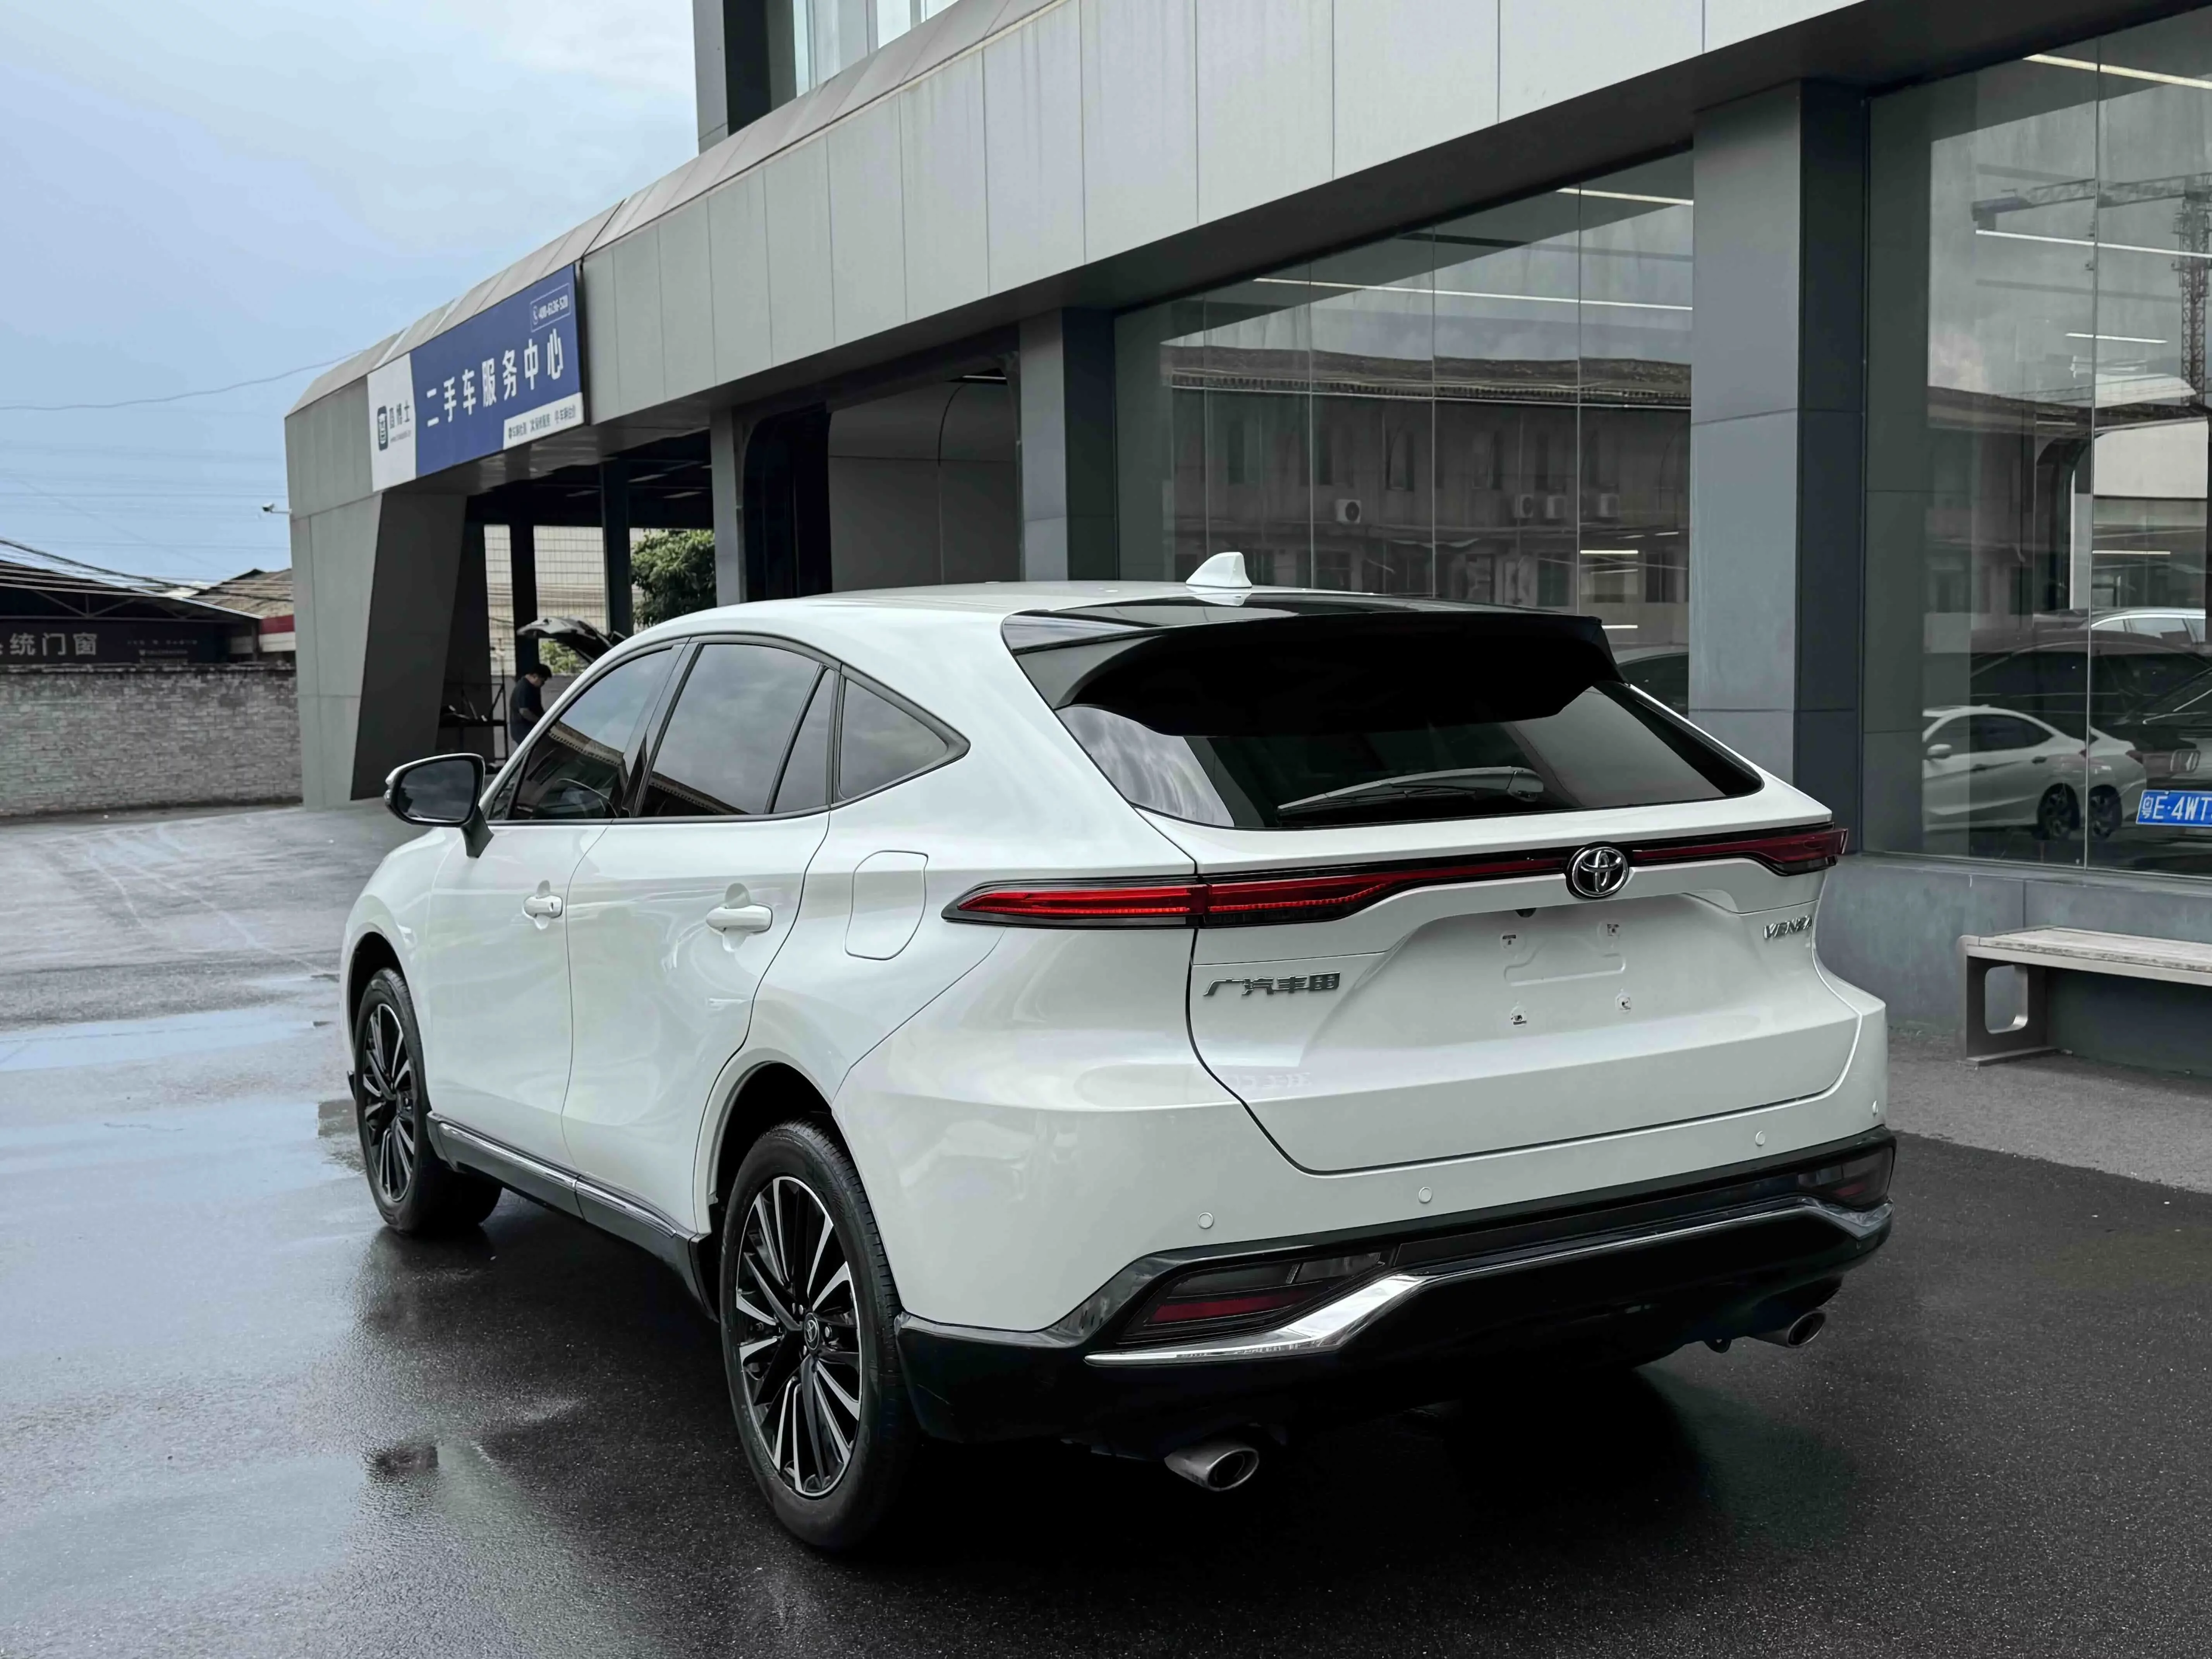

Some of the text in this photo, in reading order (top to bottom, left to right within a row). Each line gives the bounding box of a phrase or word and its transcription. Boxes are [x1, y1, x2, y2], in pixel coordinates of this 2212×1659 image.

[427, 328, 563, 427] 二手车服务中心
[0, 632, 97, 656] 统门窗
[2142, 795, 2212, 821] 粤E·4WT
[1203, 971, 1340, 996] 广汽丰田
